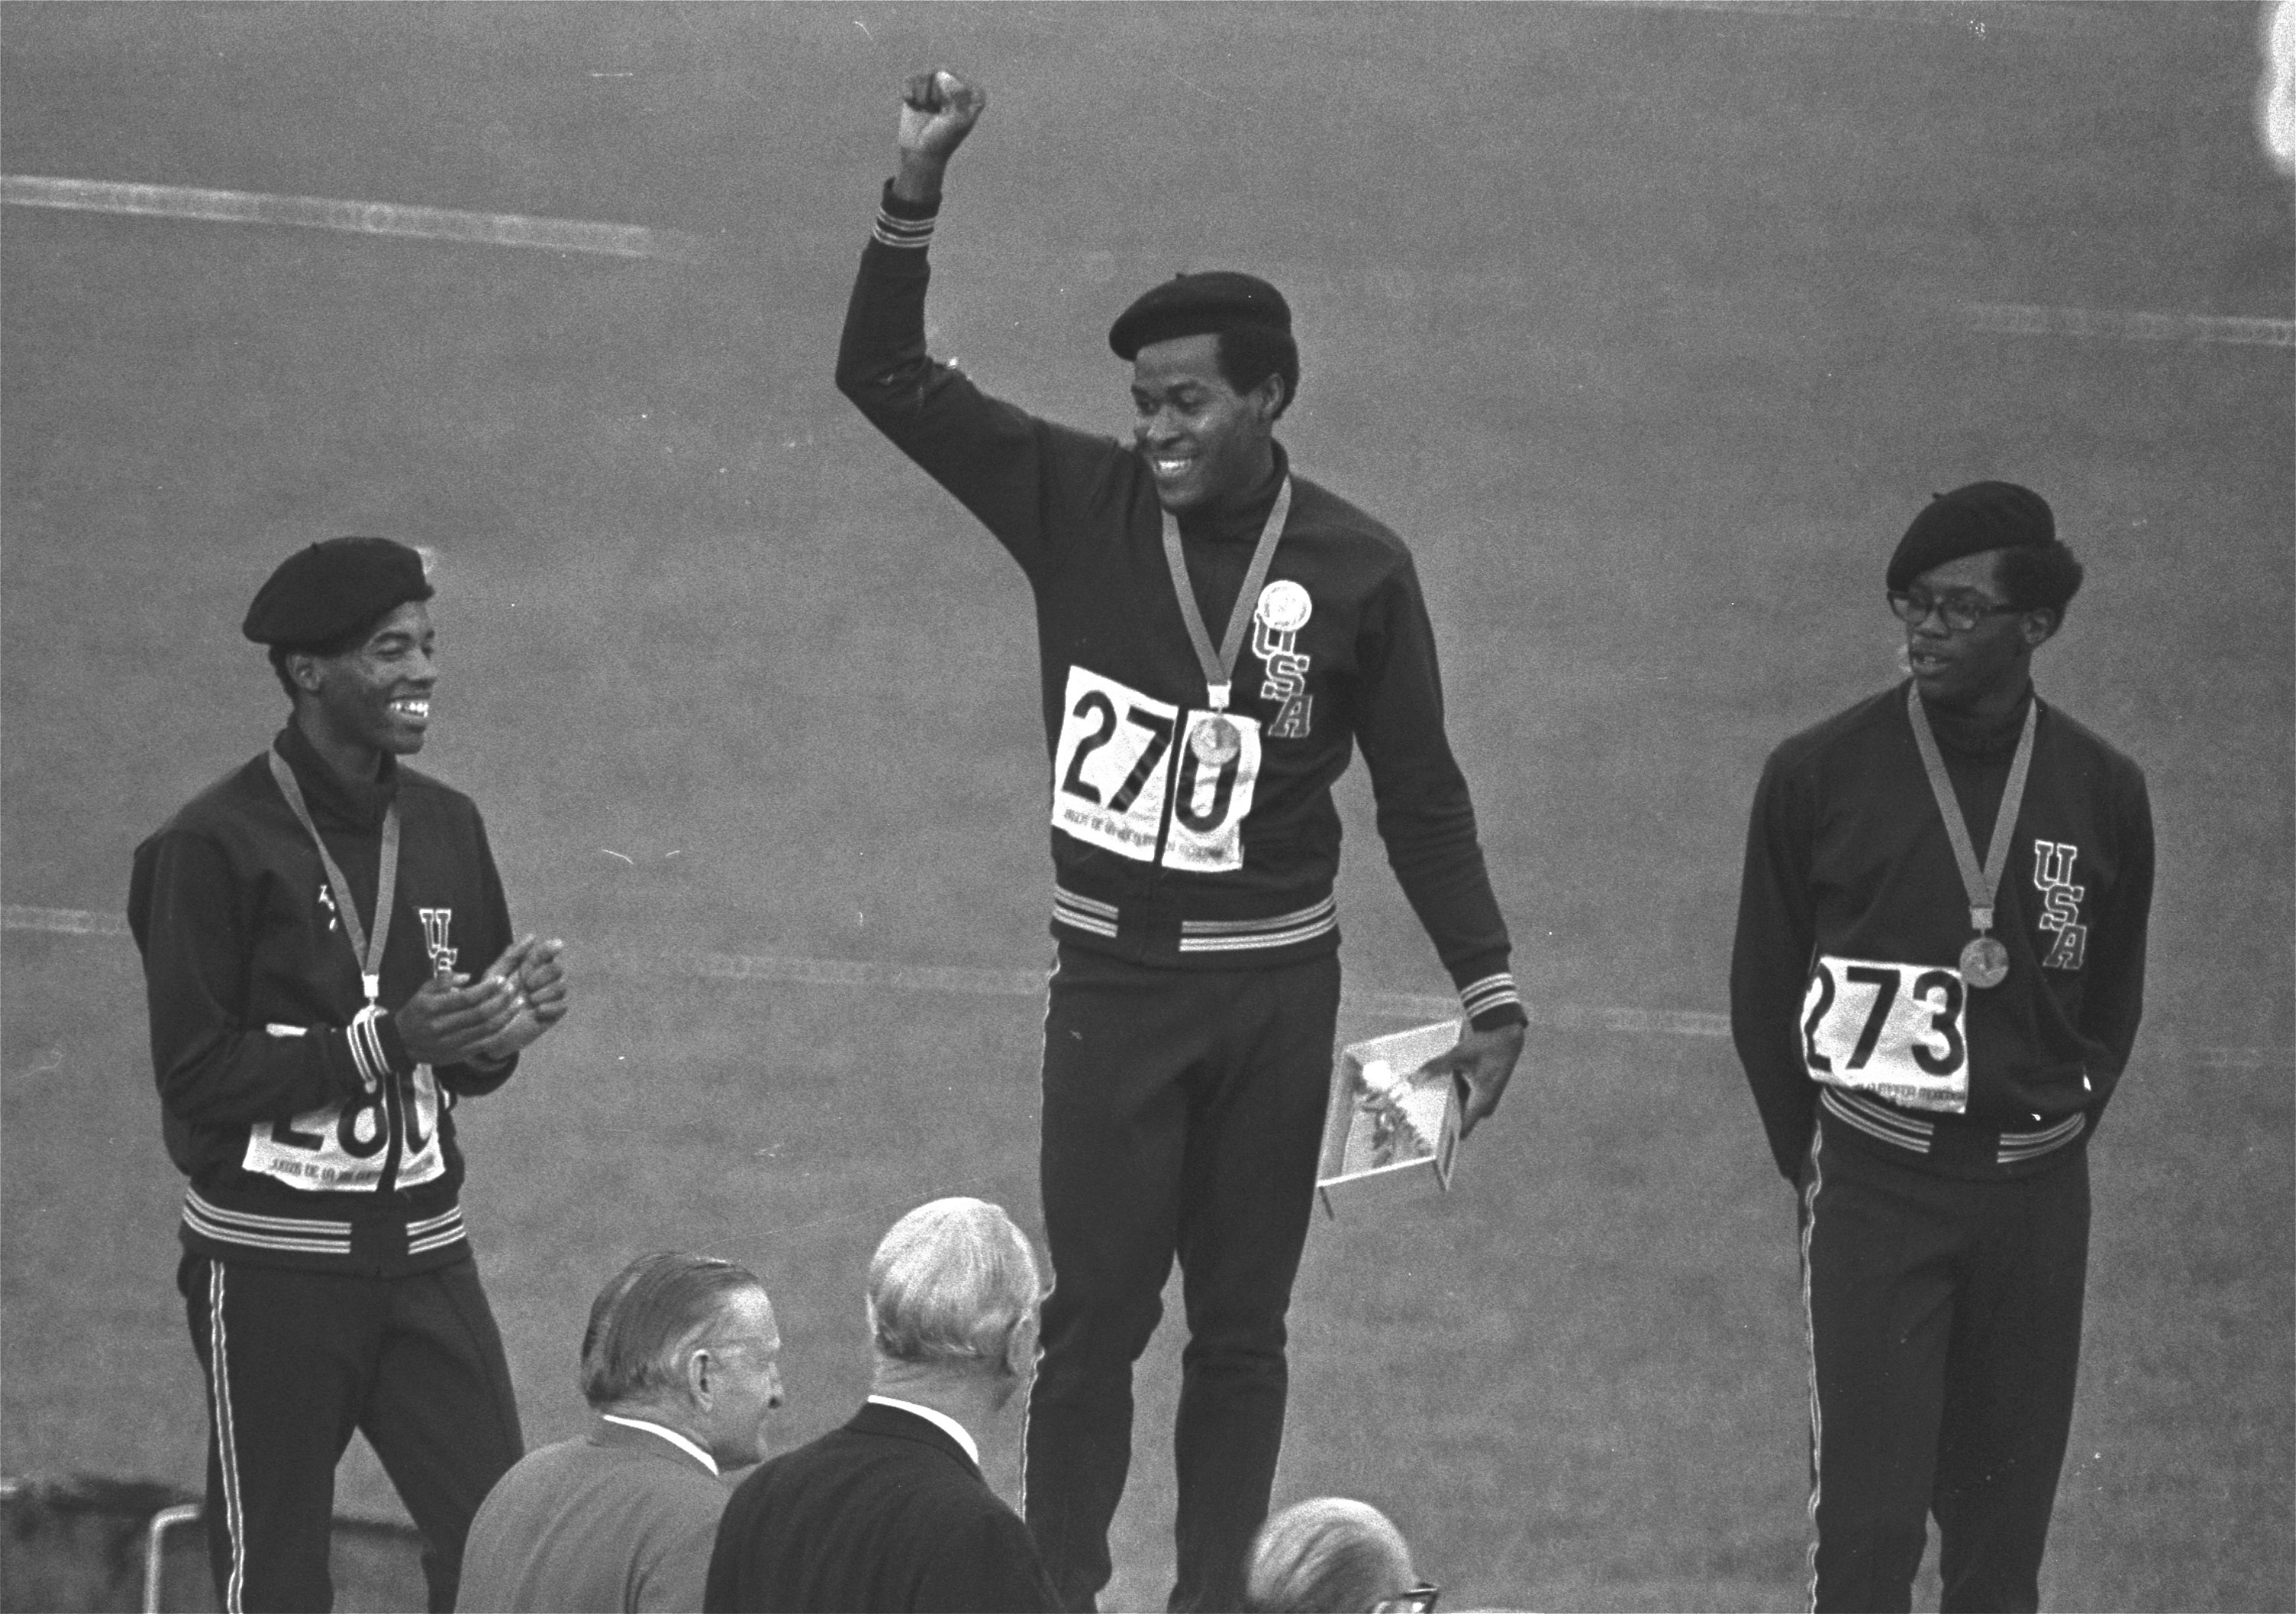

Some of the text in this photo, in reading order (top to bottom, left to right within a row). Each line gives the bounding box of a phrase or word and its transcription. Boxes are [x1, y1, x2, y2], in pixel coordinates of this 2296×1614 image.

[1062, 690, 1241, 833] 270
[2034, 839, 2087, 970] USA
[1804, 964, 1965, 1077] 273
